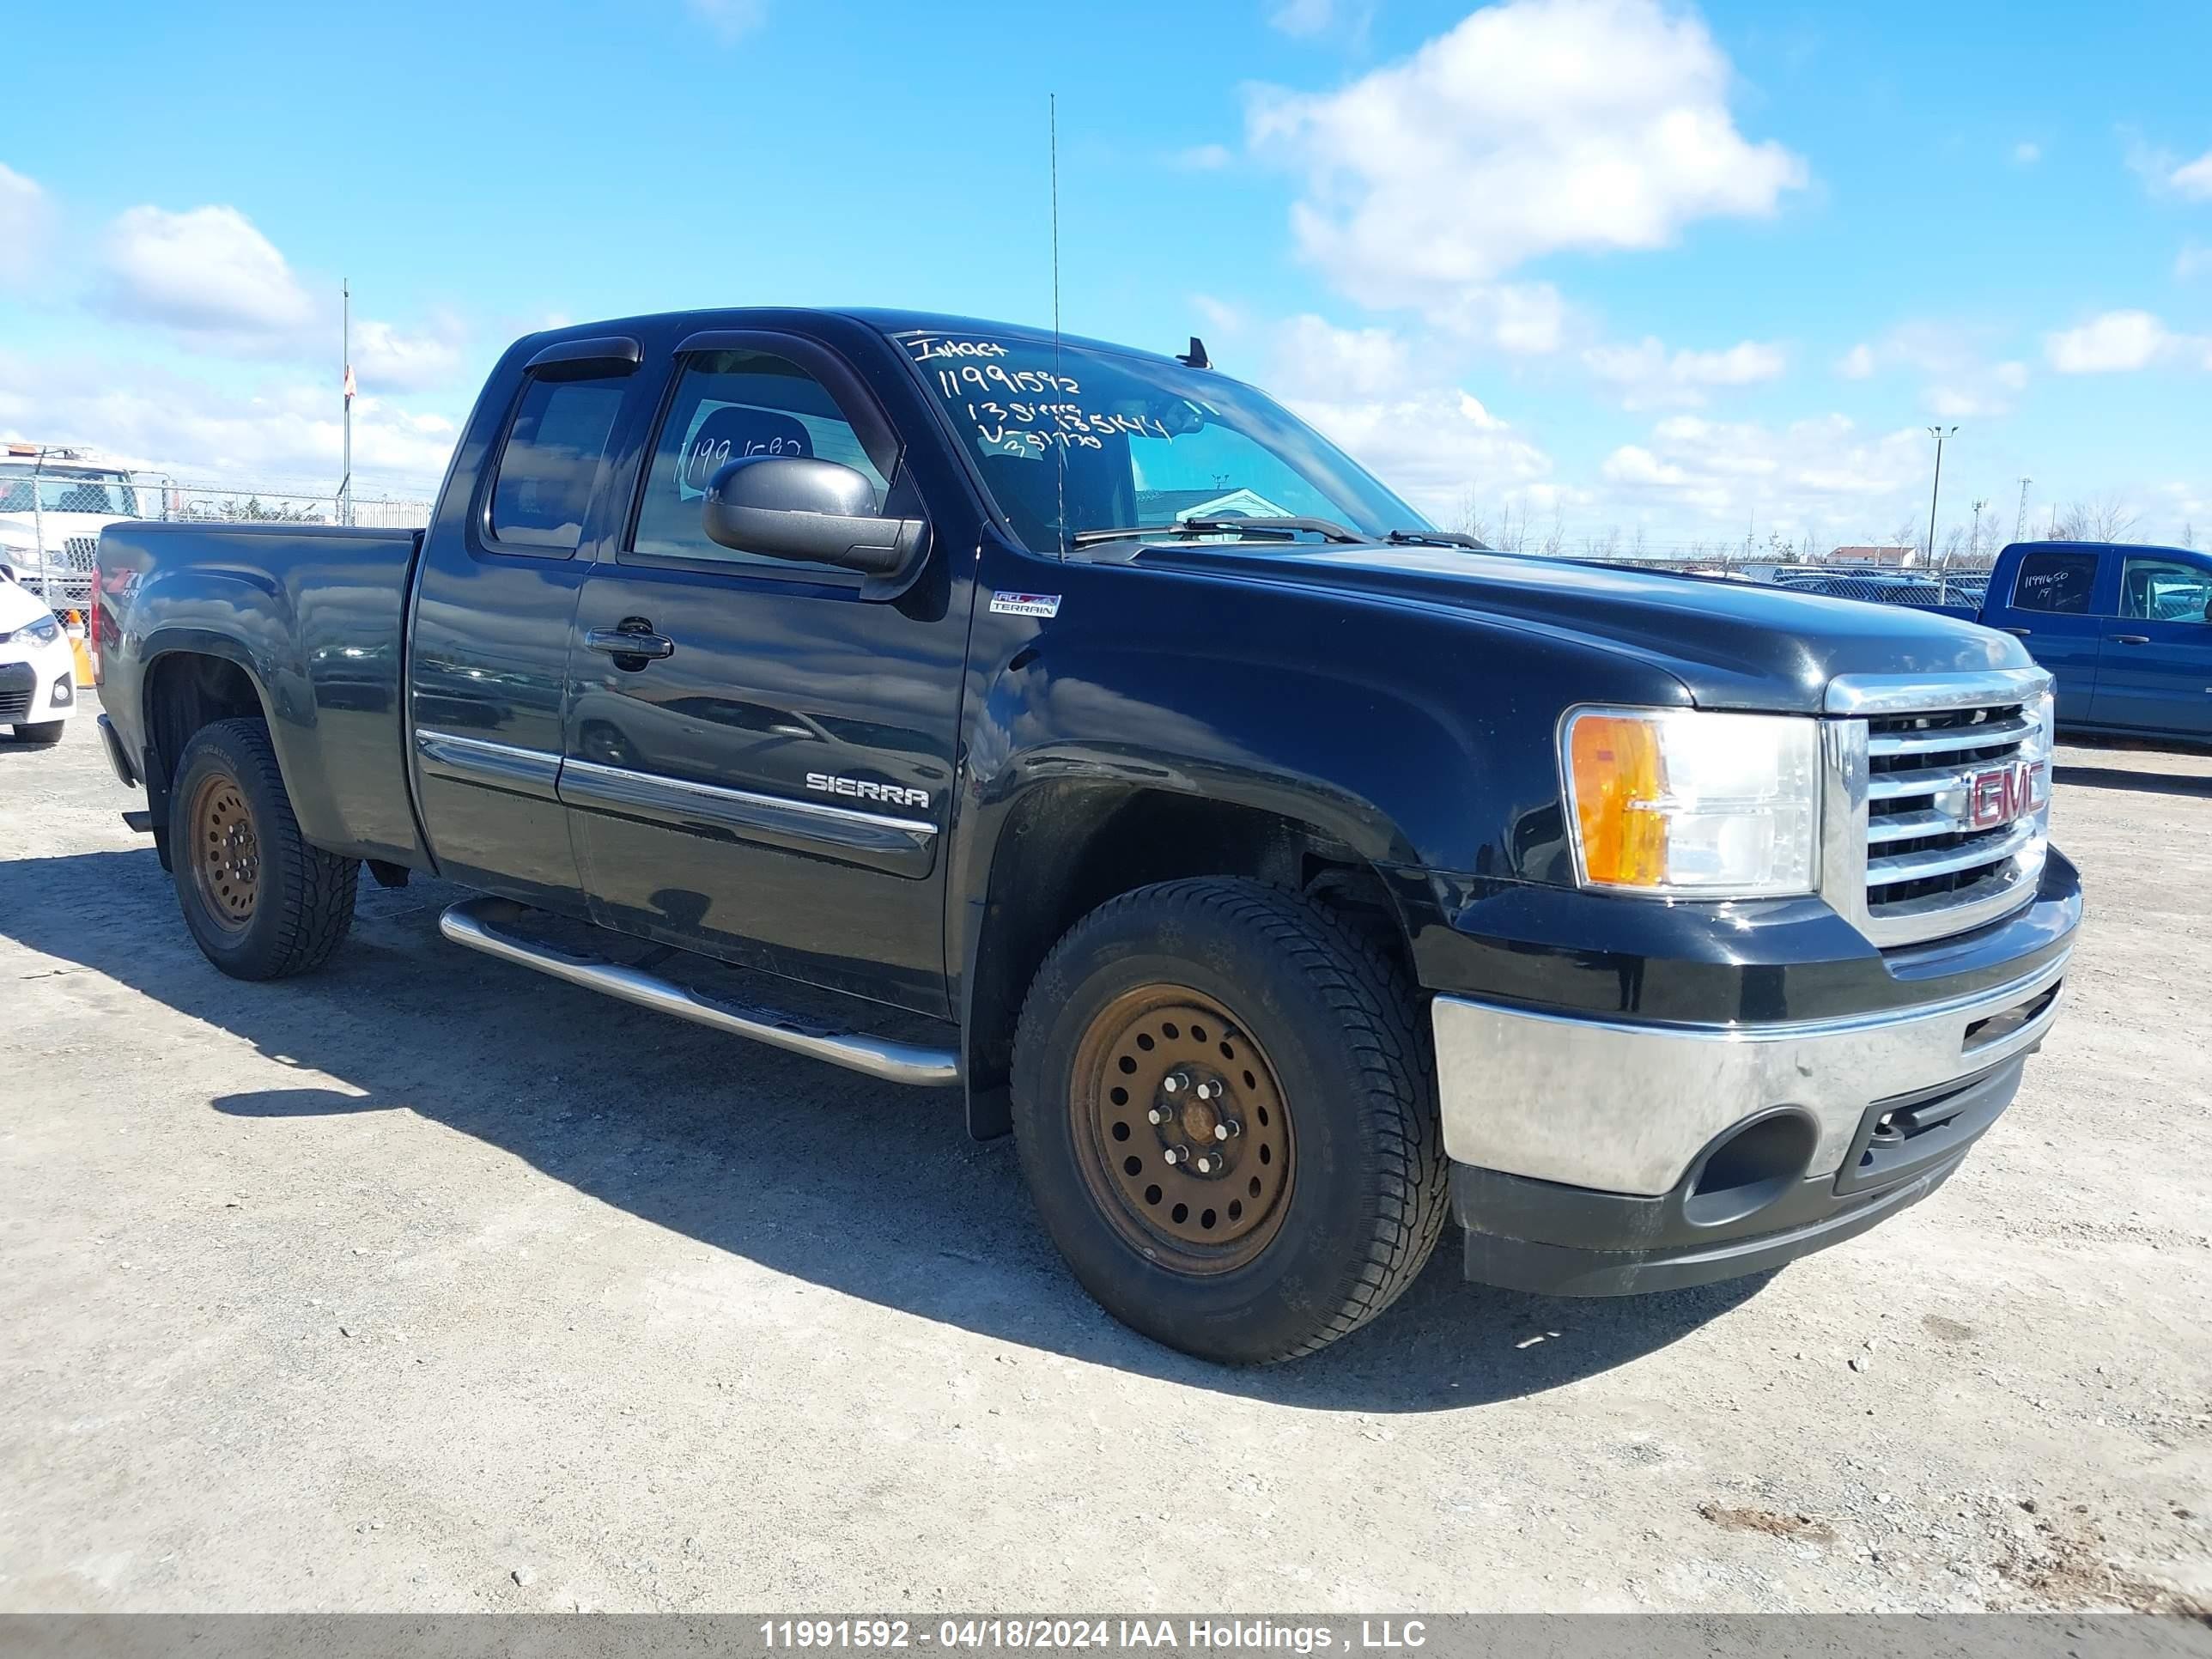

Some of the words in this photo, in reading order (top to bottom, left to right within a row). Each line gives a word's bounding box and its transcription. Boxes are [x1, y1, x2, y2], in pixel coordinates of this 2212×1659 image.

[939, 365, 1080, 398] 11991592
[2025, 571, 2069, 589] 11991650
[994, 603, 1054, 615] TERRAIN
[998, 592, 1024, 603] ALL
[805, 772, 929, 810] SIERRA
[1971, 759, 2046, 828] GMC
